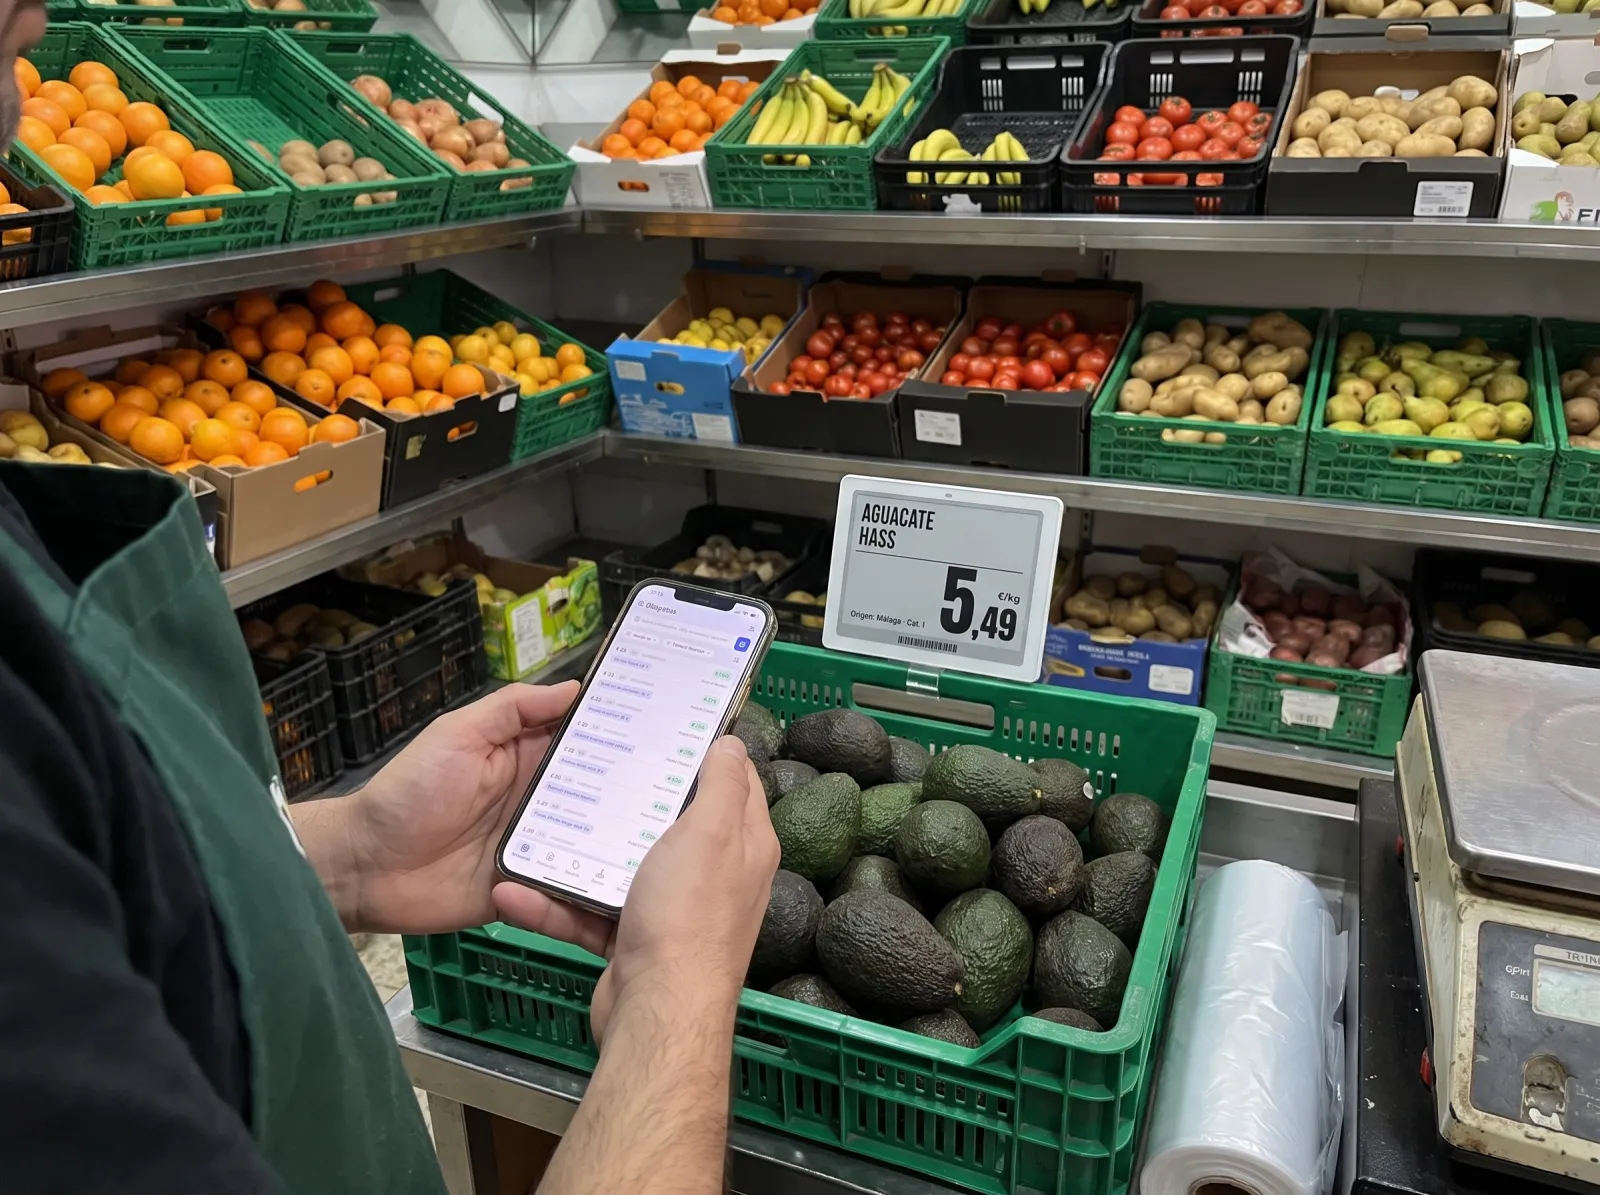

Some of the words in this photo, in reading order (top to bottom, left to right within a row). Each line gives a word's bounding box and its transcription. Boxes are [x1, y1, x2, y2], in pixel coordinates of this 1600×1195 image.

[861, 503, 935, 530] AGUACATE
[858, 526, 897, 550] HASS
[997, 591, 1021, 605] €/kg
[850, 609, 875, 621] Origen:
[906, 618, 921, 628] Cat.
